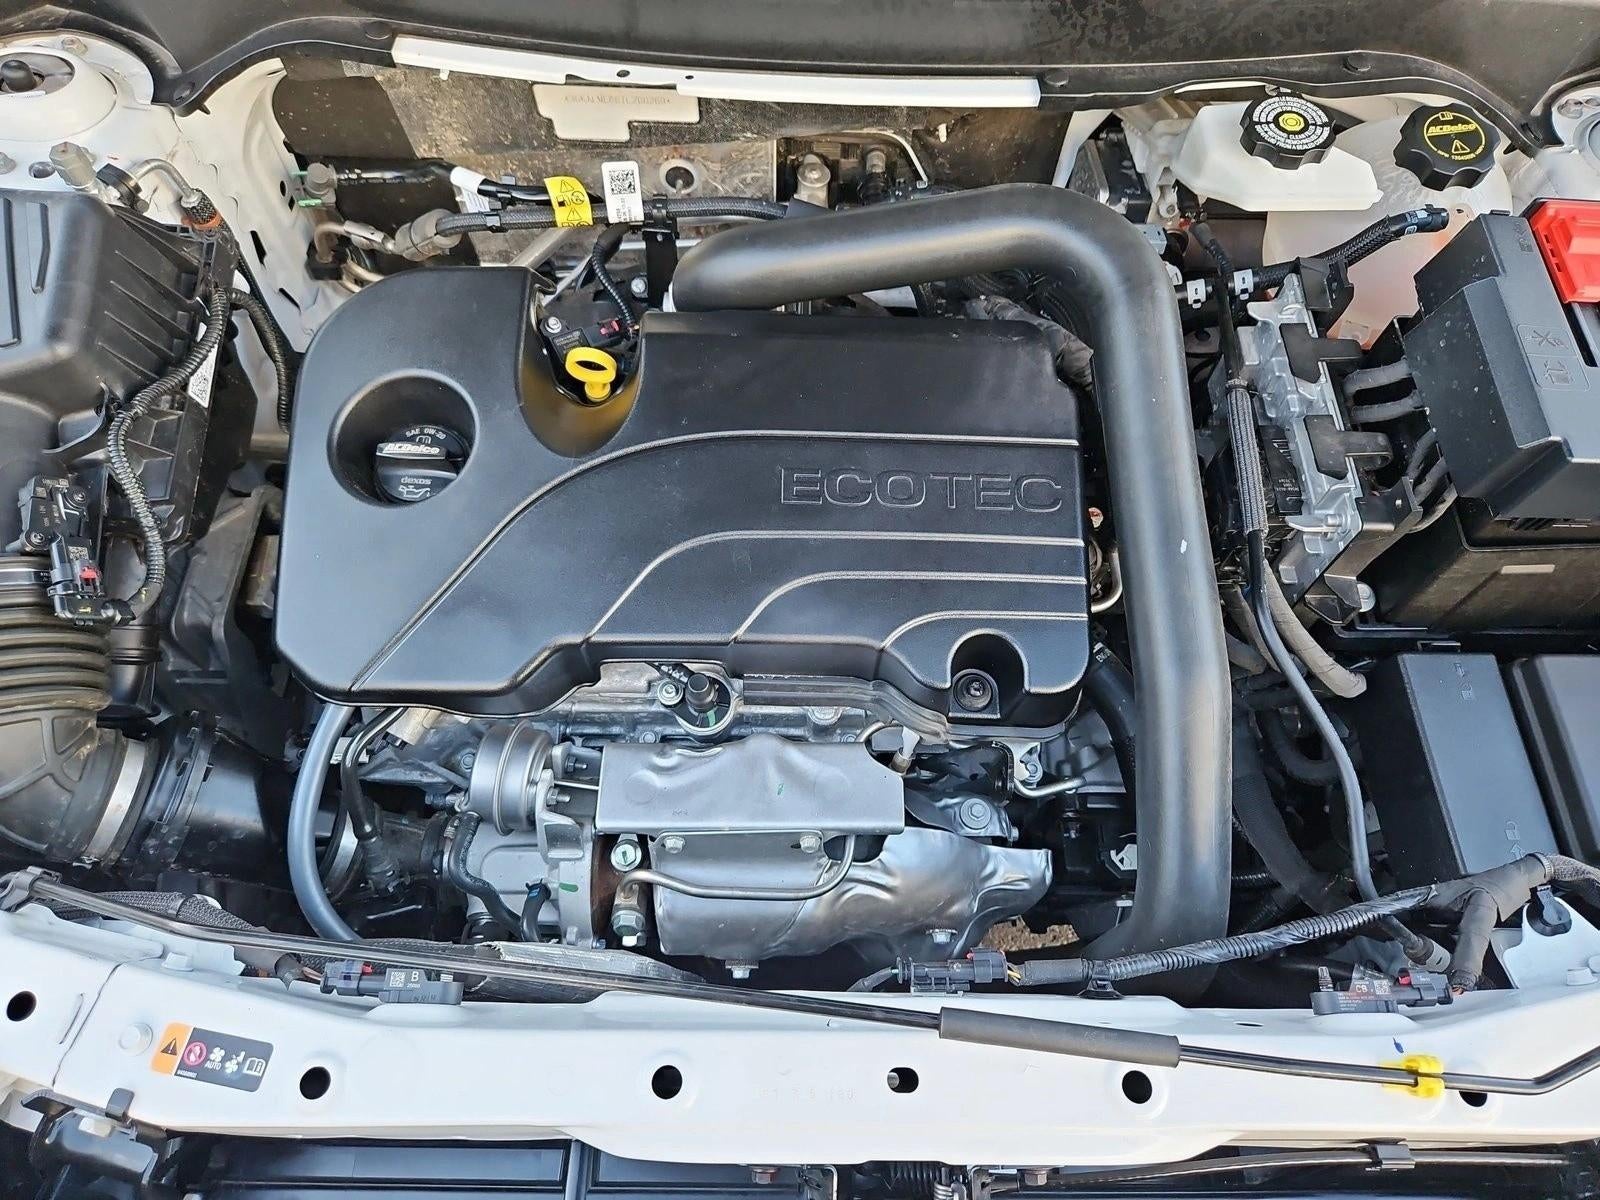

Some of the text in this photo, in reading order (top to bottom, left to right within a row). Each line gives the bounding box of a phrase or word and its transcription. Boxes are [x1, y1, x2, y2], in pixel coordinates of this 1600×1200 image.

[1427, 123, 1477, 136] ACDelco
[405, 428, 420, 437] SAE
[383, 443, 441, 455] ACDelco
[400, 476, 432, 485] dexos
[780, 466, 1063, 514] ECOTEC
[411, 971, 420, 982] B
[205, 1060, 222, 1070] AUTO
